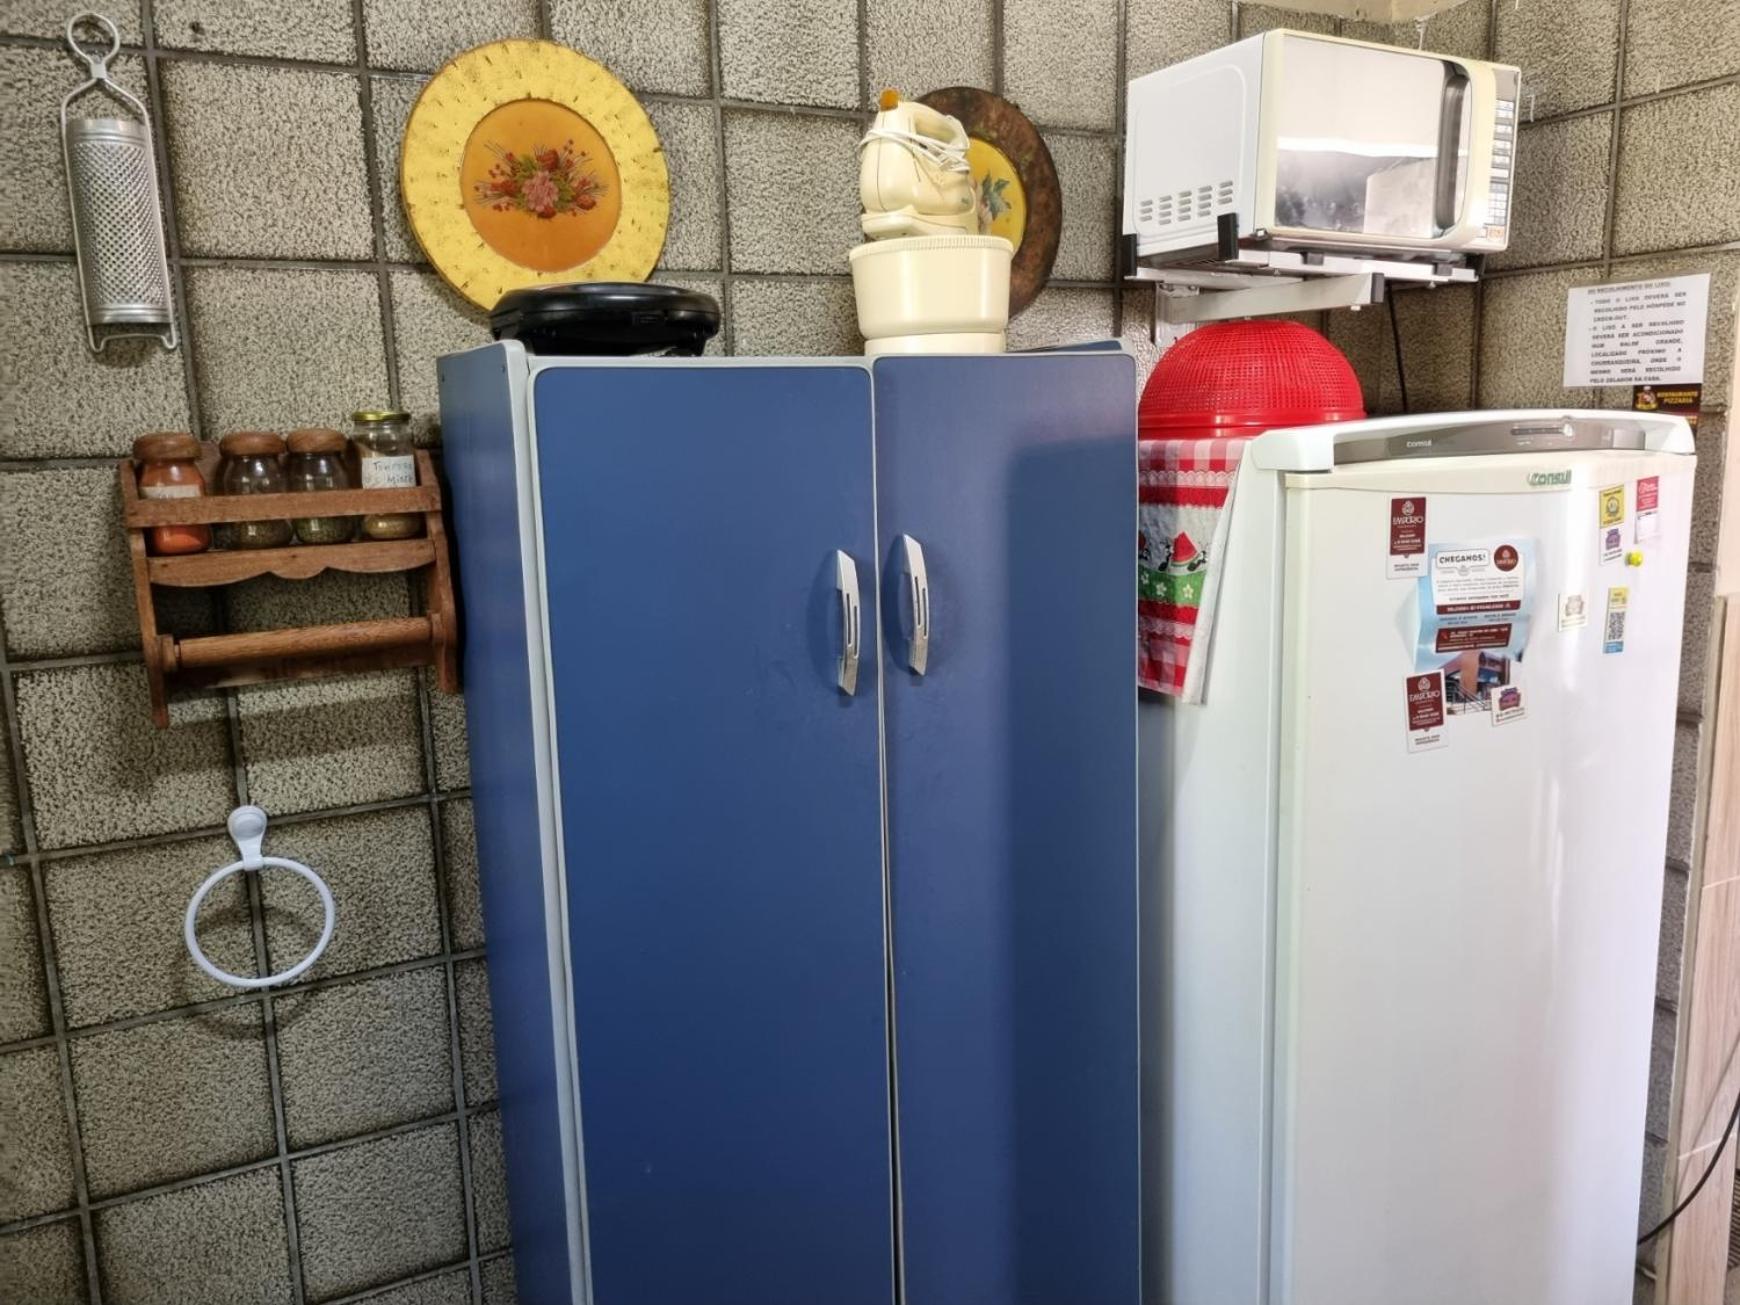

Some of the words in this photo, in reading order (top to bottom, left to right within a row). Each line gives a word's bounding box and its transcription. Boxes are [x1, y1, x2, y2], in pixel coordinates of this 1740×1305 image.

[1648, 319, 1685, 327] RECOLHIDO
[1632, 329, 1684, 338] ACONDICIONADO
[1591, 350, 1628, 358] LOCALIZADO
[1645, 365, 1681, 373] RECOLHIDO
[1406, 439, 1433, 448] consul
